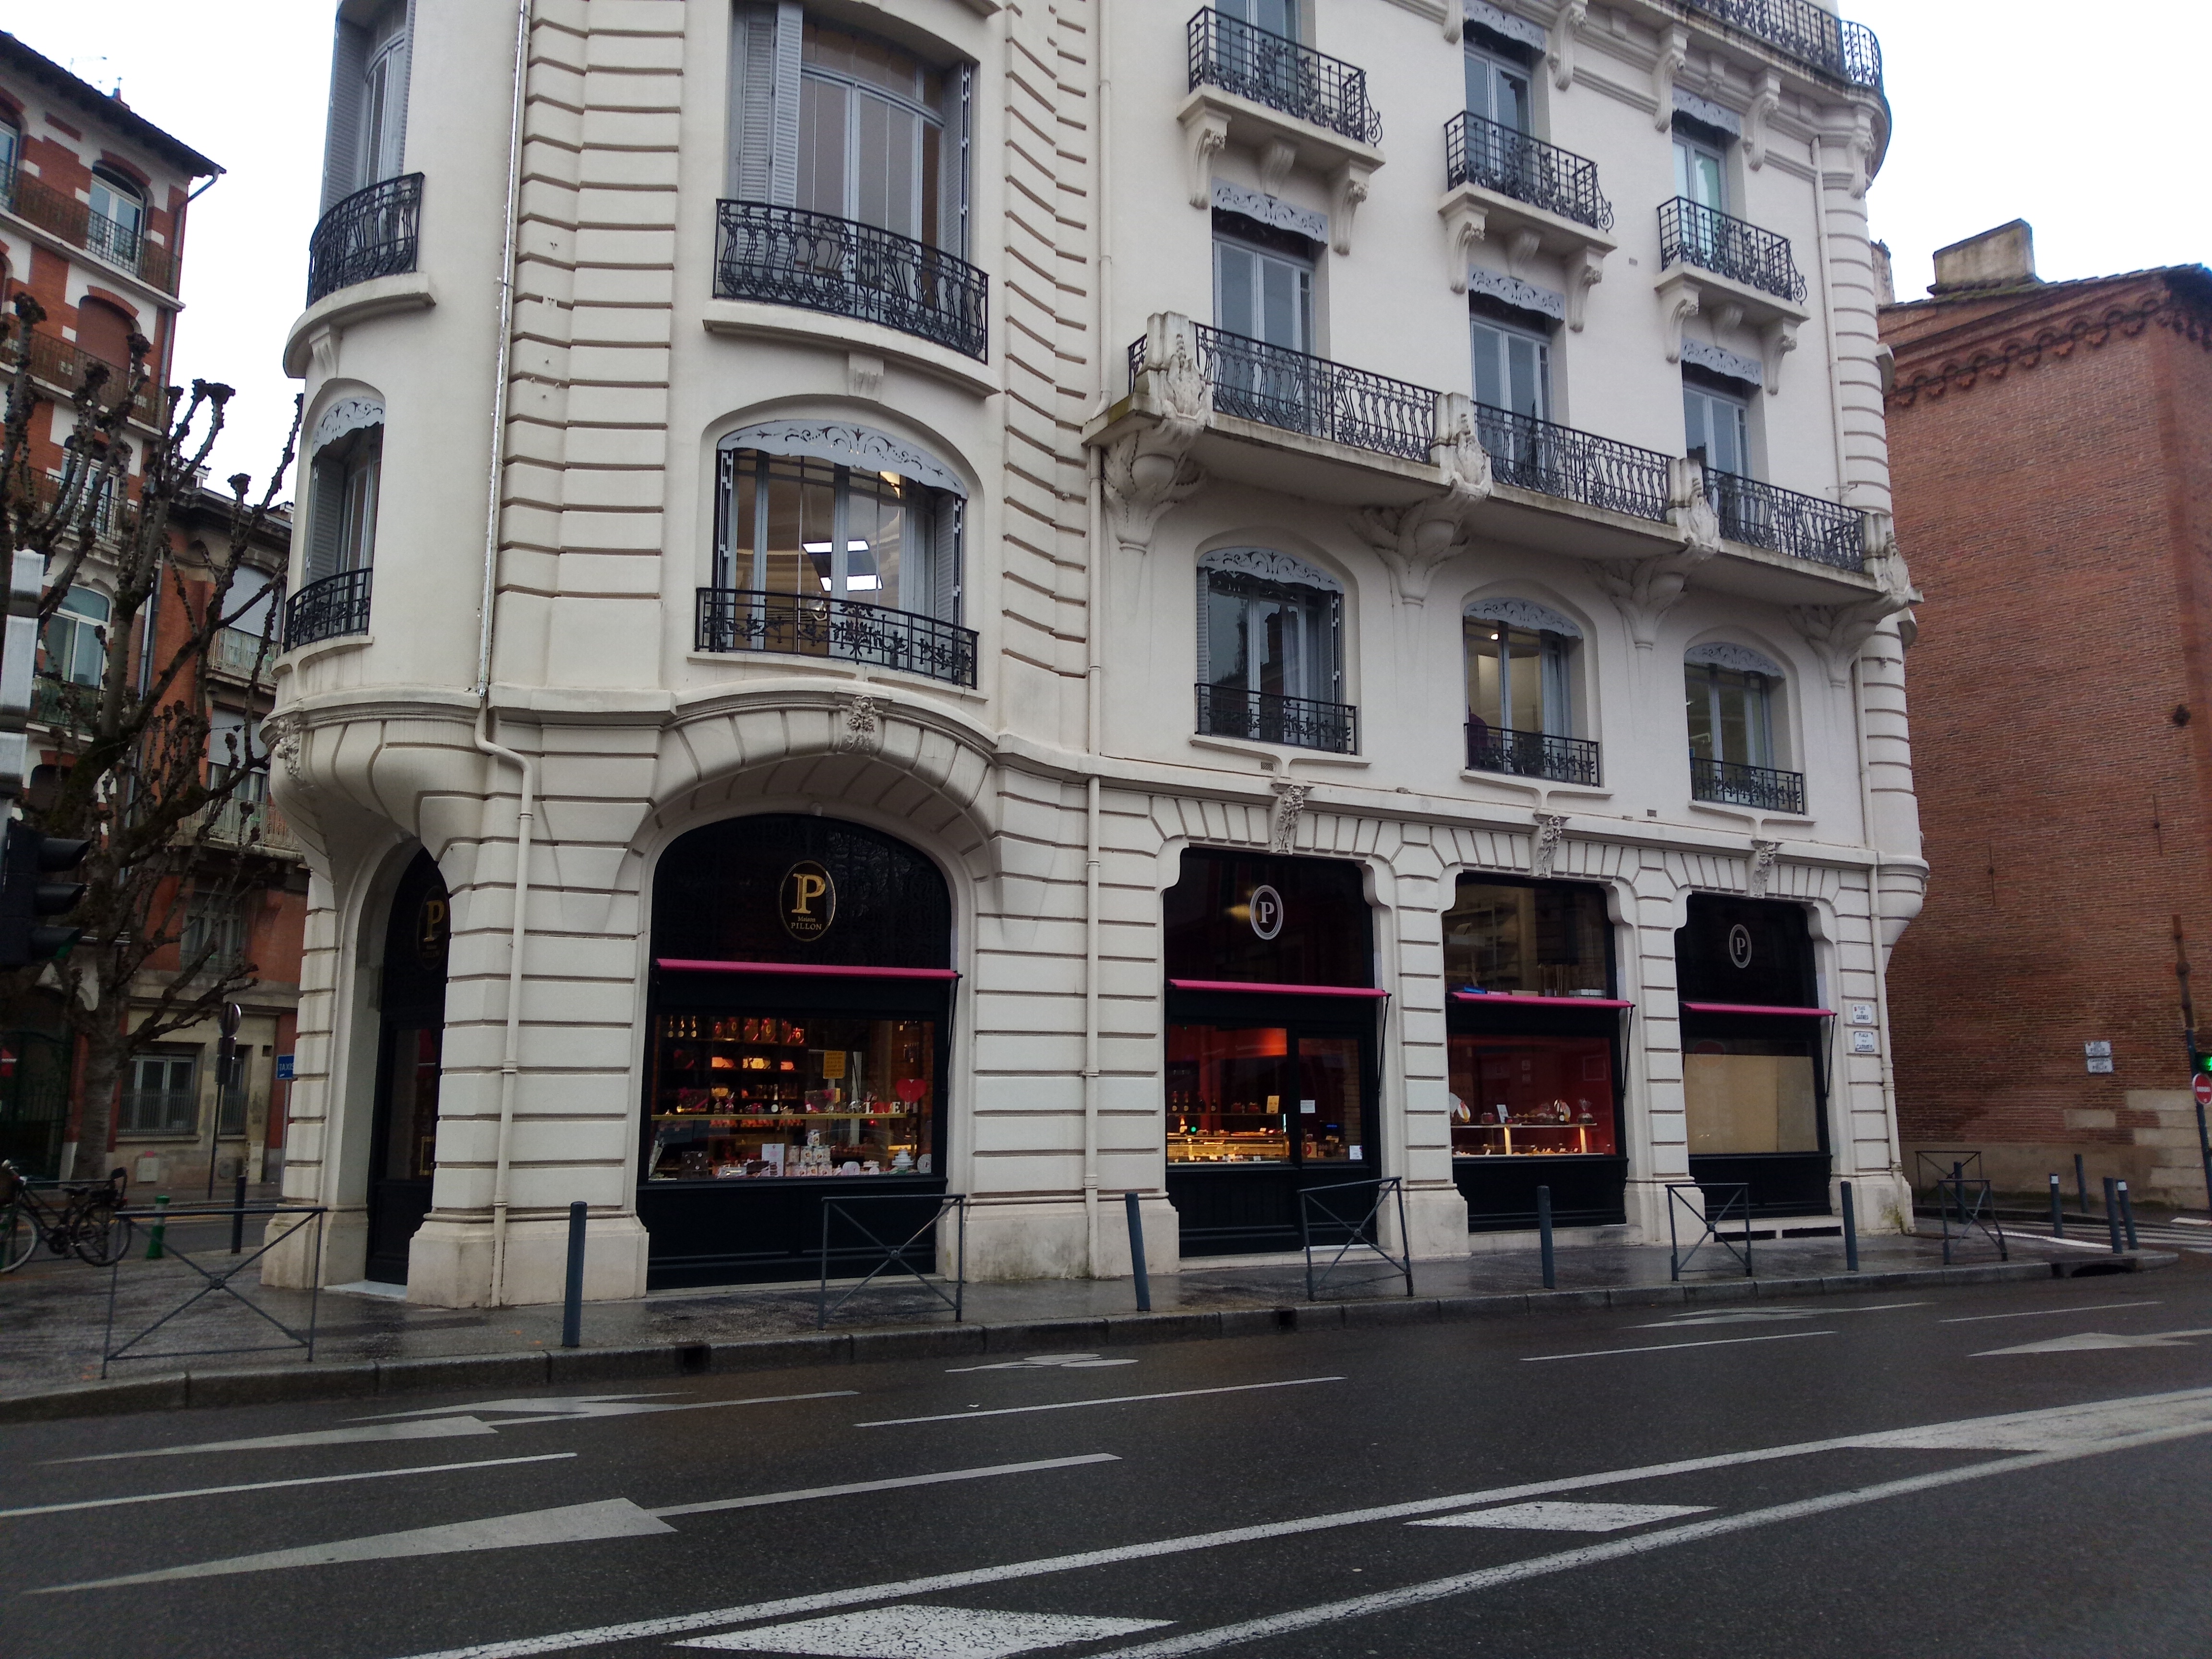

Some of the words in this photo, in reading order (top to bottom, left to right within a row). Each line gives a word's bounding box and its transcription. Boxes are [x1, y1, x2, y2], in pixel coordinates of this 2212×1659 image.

[791, 873, 826, 914] P
[423, 900, 445, 942] P
[1259, 901, 1274, 923] P
[791, 922, 822, 930] PILLON
[1735, 937, 1746, 955] P
